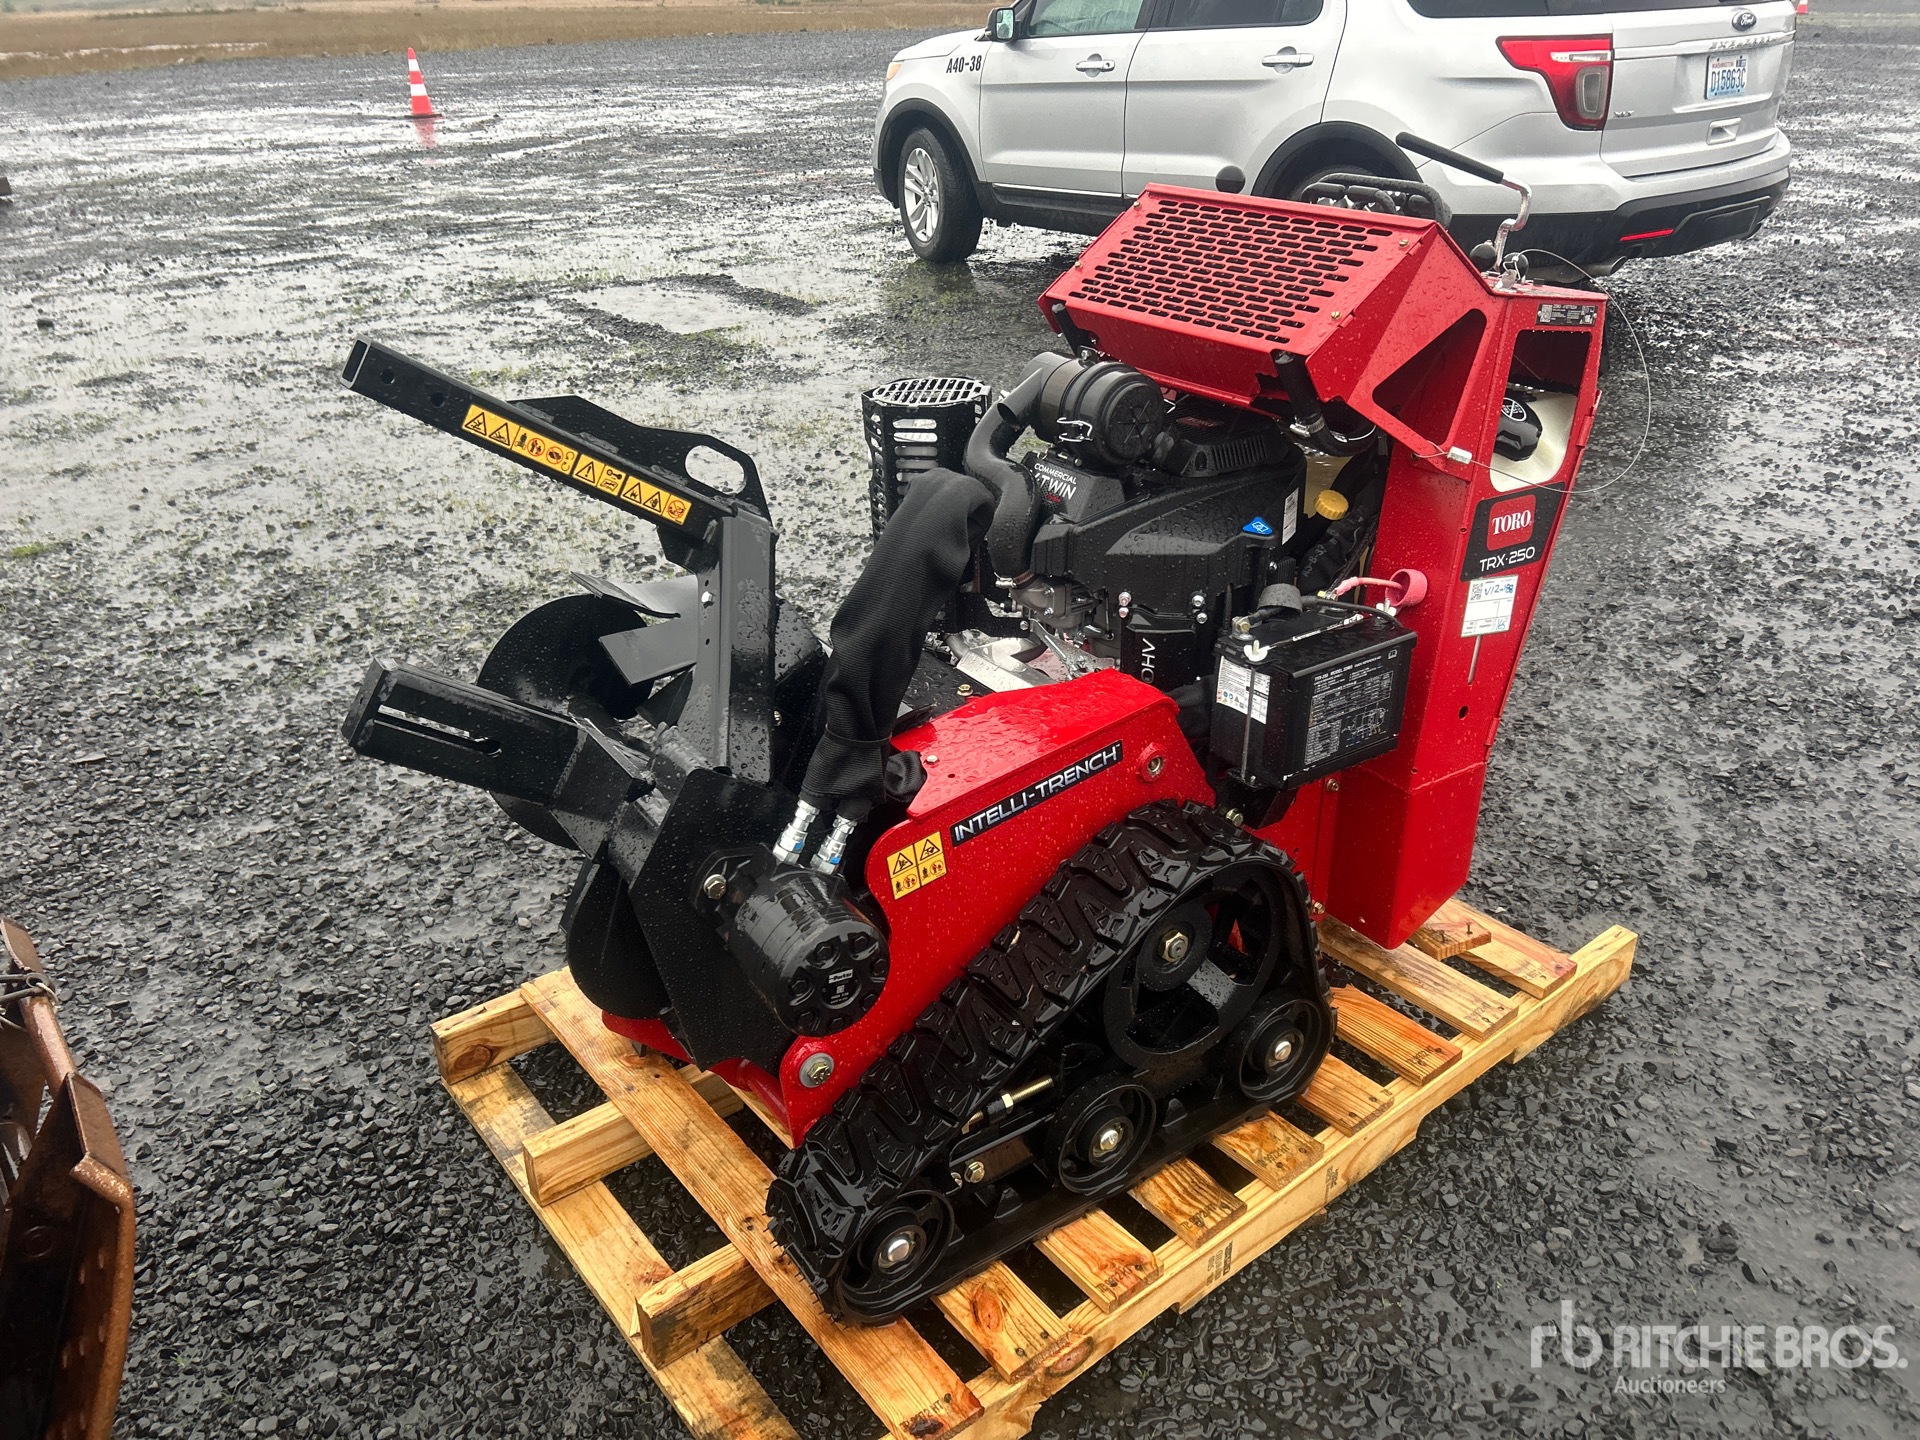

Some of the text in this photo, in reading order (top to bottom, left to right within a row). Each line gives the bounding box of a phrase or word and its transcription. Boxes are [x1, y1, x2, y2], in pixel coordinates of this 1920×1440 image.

[946, 54, 983, 74] A40-38
[1710, 68, 1746, 93] D15863C
[1034, 463, 1077, 485] COMMERCIAL
[1492, 509, 1532, 535] TORO
[1141, 637, 1156, 684] OHV
[953, 745, 1119, 842] INTELLI-TRENCH
